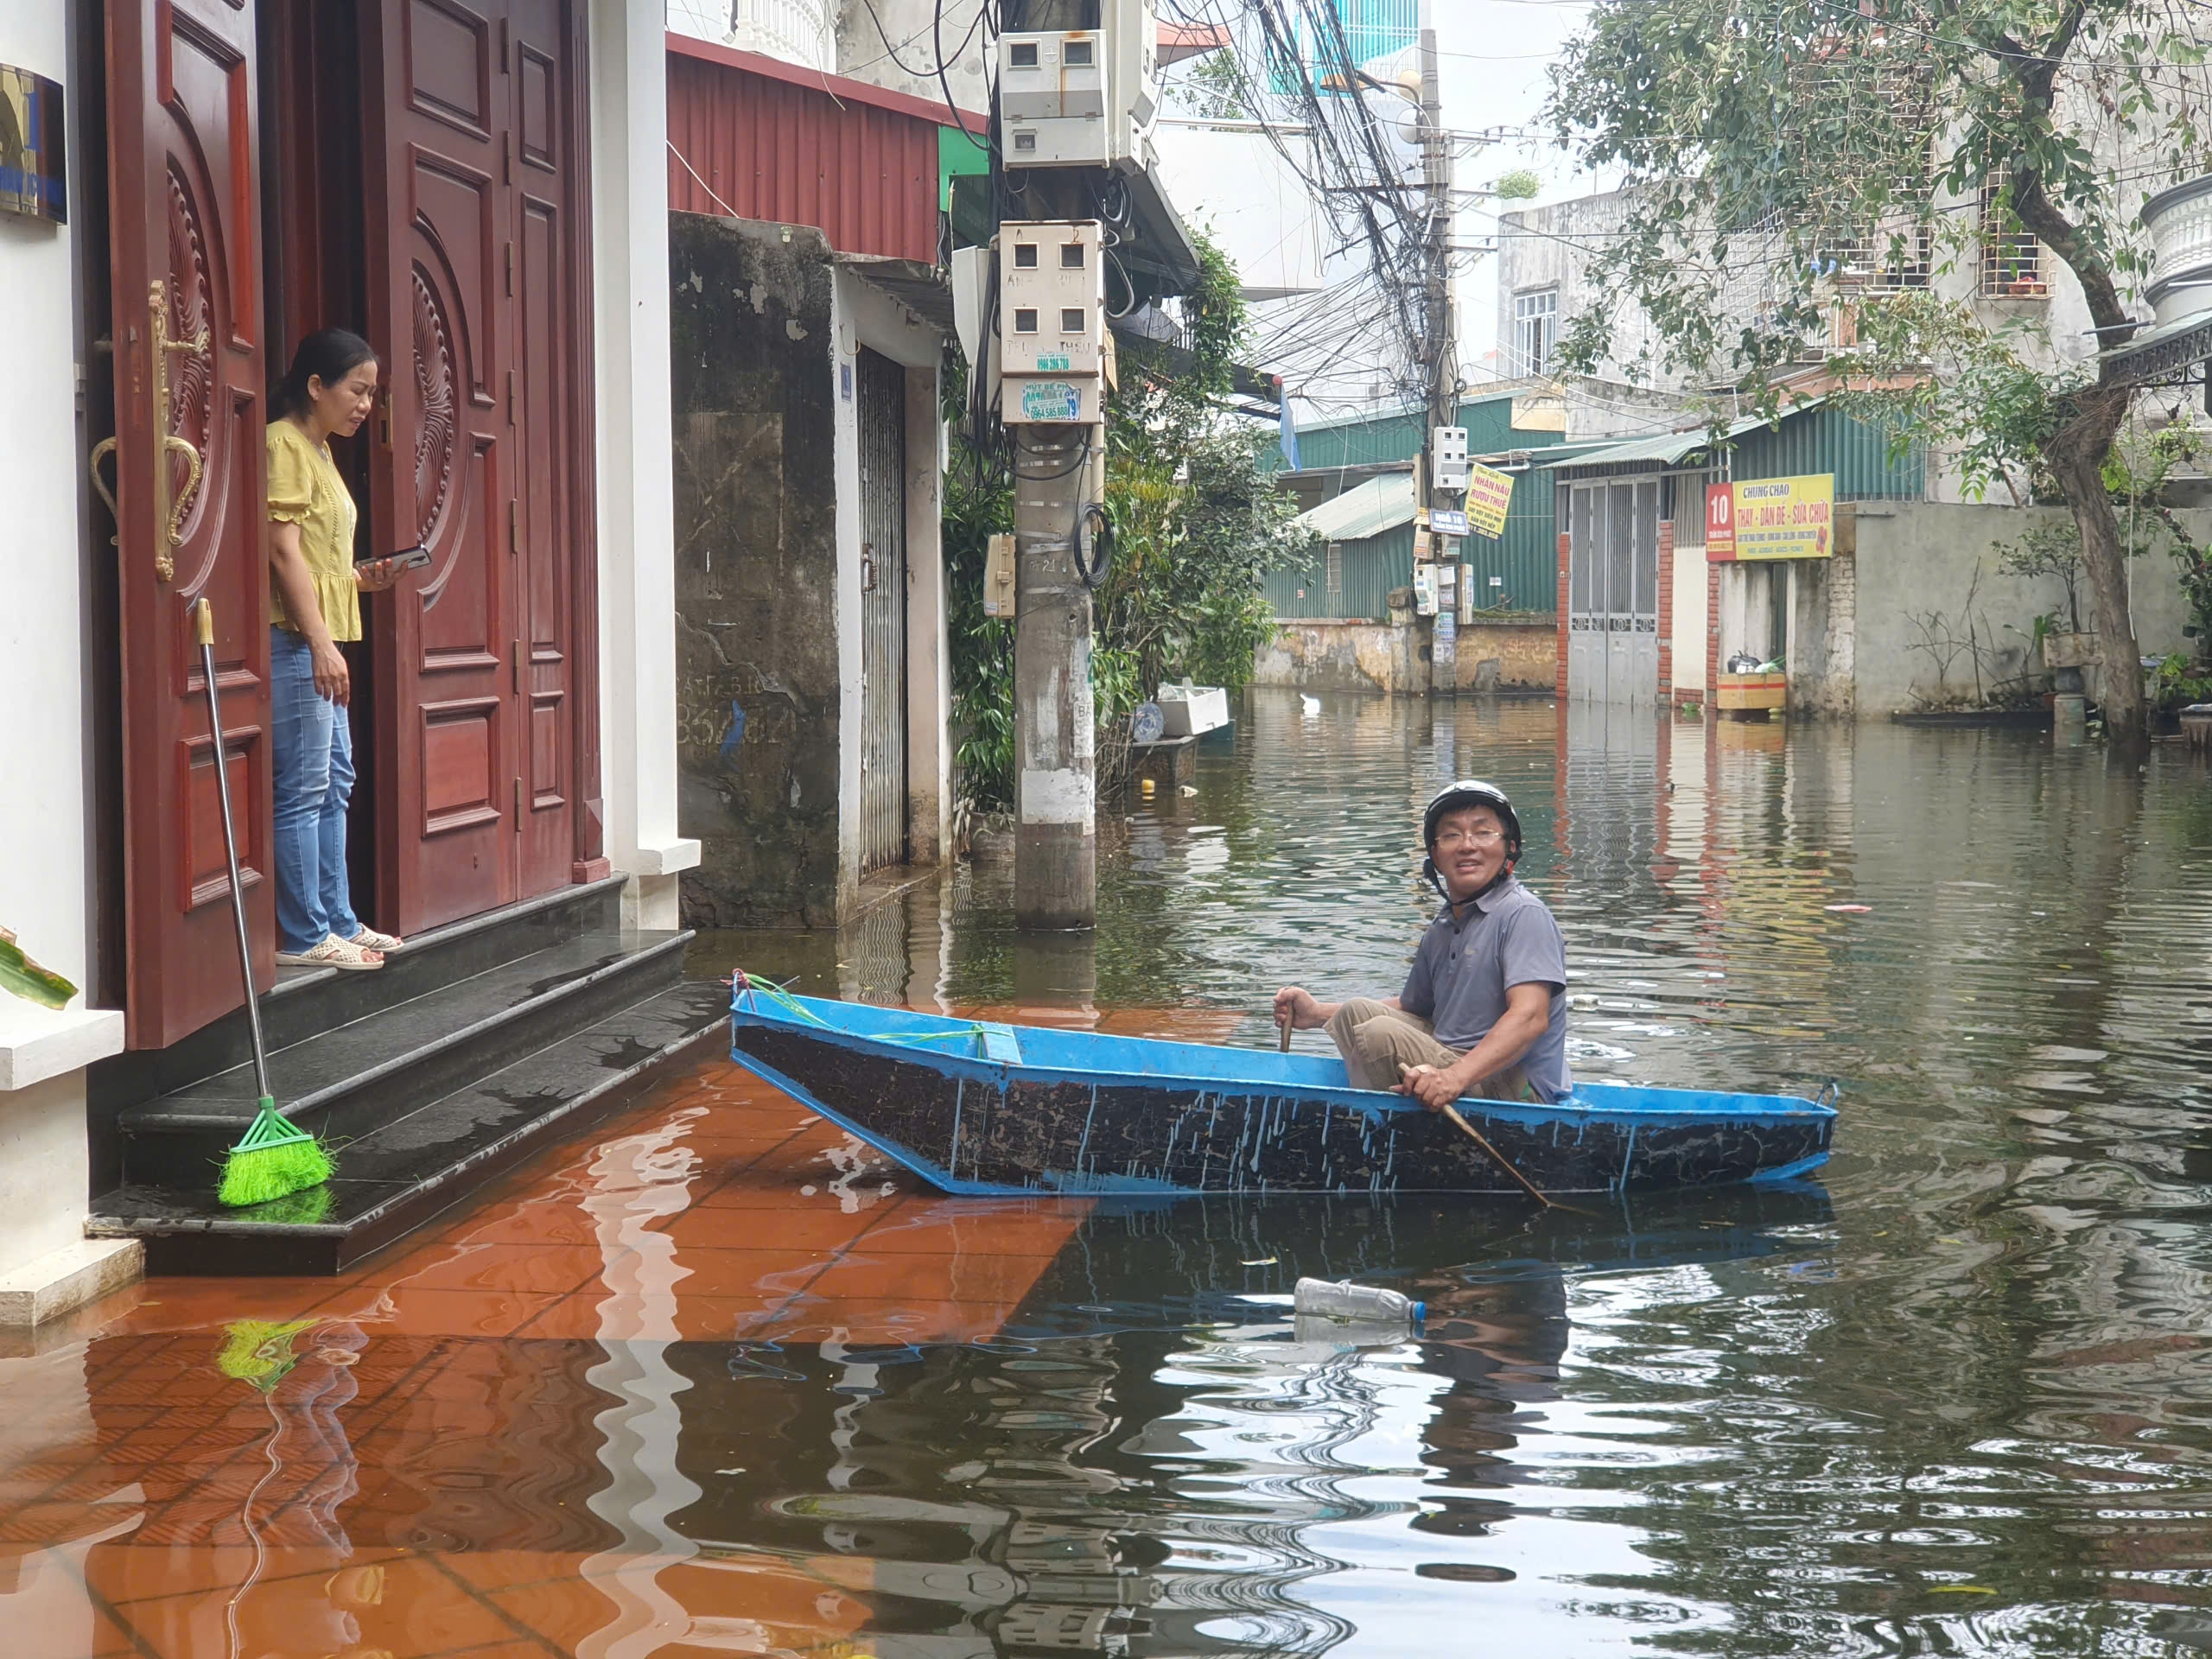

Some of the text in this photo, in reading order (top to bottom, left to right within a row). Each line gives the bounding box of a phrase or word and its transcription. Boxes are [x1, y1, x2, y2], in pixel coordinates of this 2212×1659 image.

[1744, 485, 1768, 499] CHUNG
[1711, 495, 1728, 524] 10
[1738, 508, 1753, 527] THAY
